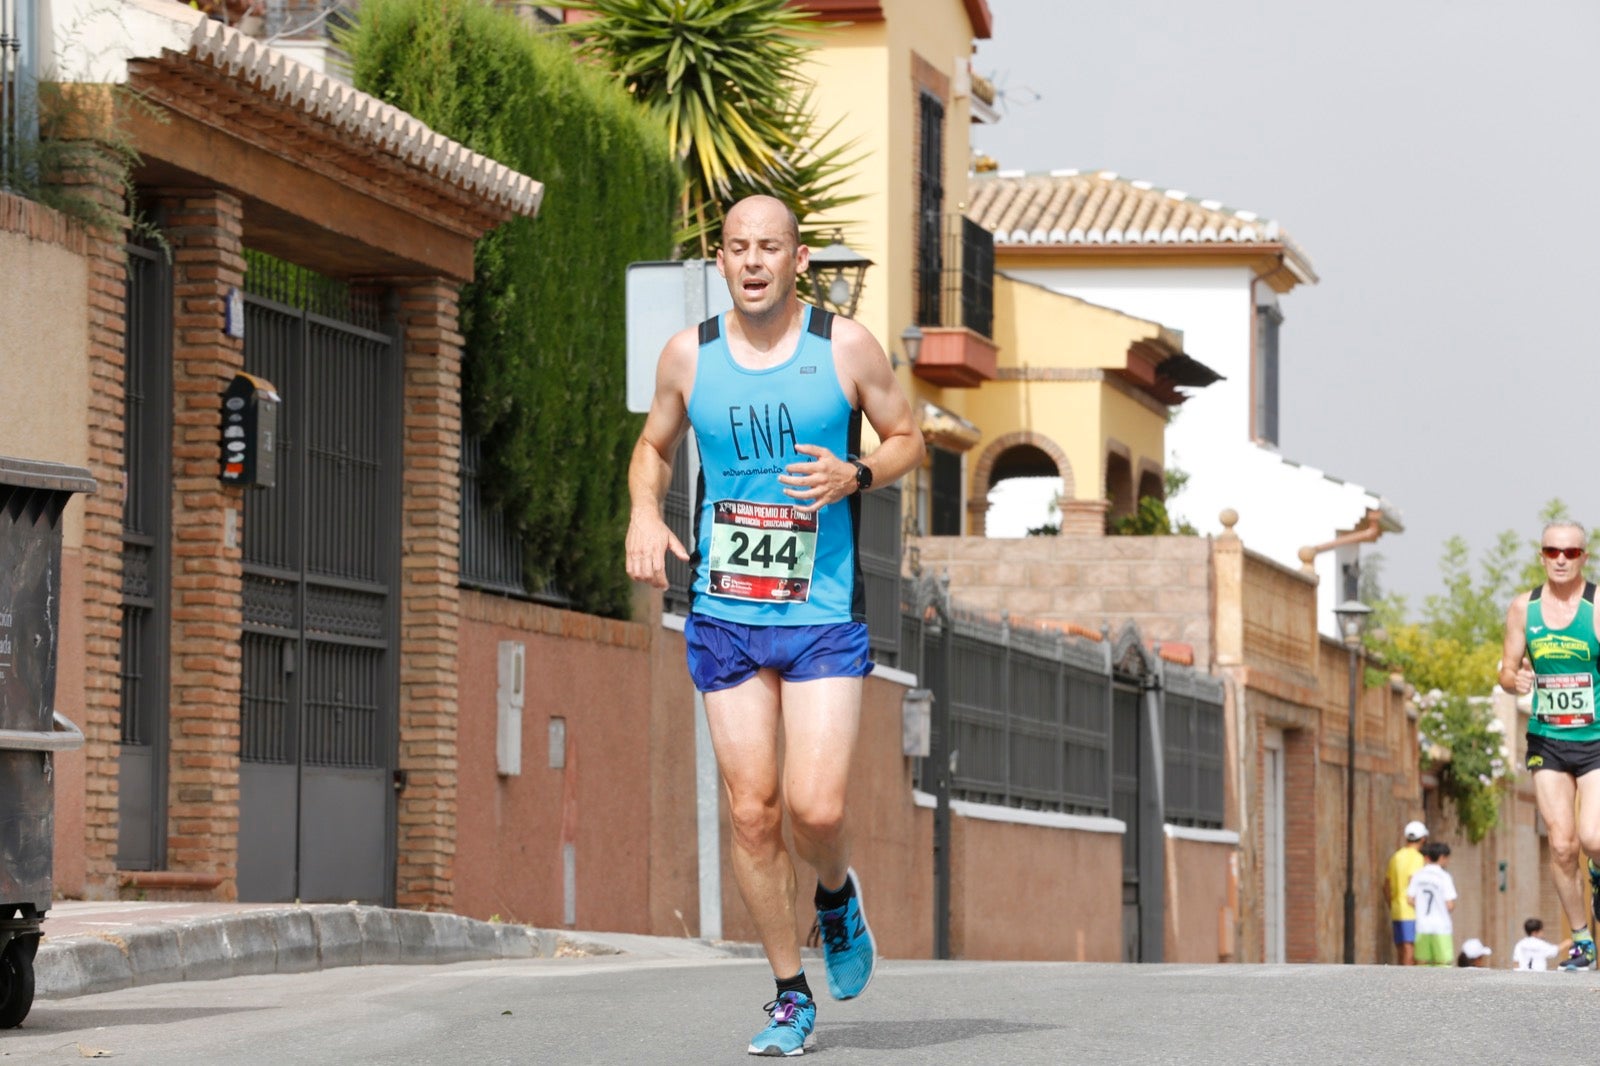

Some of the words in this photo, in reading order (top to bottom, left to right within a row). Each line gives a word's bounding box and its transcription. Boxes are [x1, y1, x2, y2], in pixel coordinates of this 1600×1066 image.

[729, 402, 798, 460] ENA
[737, 503, 754, 515] GRAN
[754, 506, 779, 518] PREMIO
[780, 507, 789, 519] DE
[762, 519, 794, 529] CRUZCAMP
[727, 531, 798, 570] 244
[1546, 691, 1584, 710] 105
[1422, 889, 1434, 916] 7
